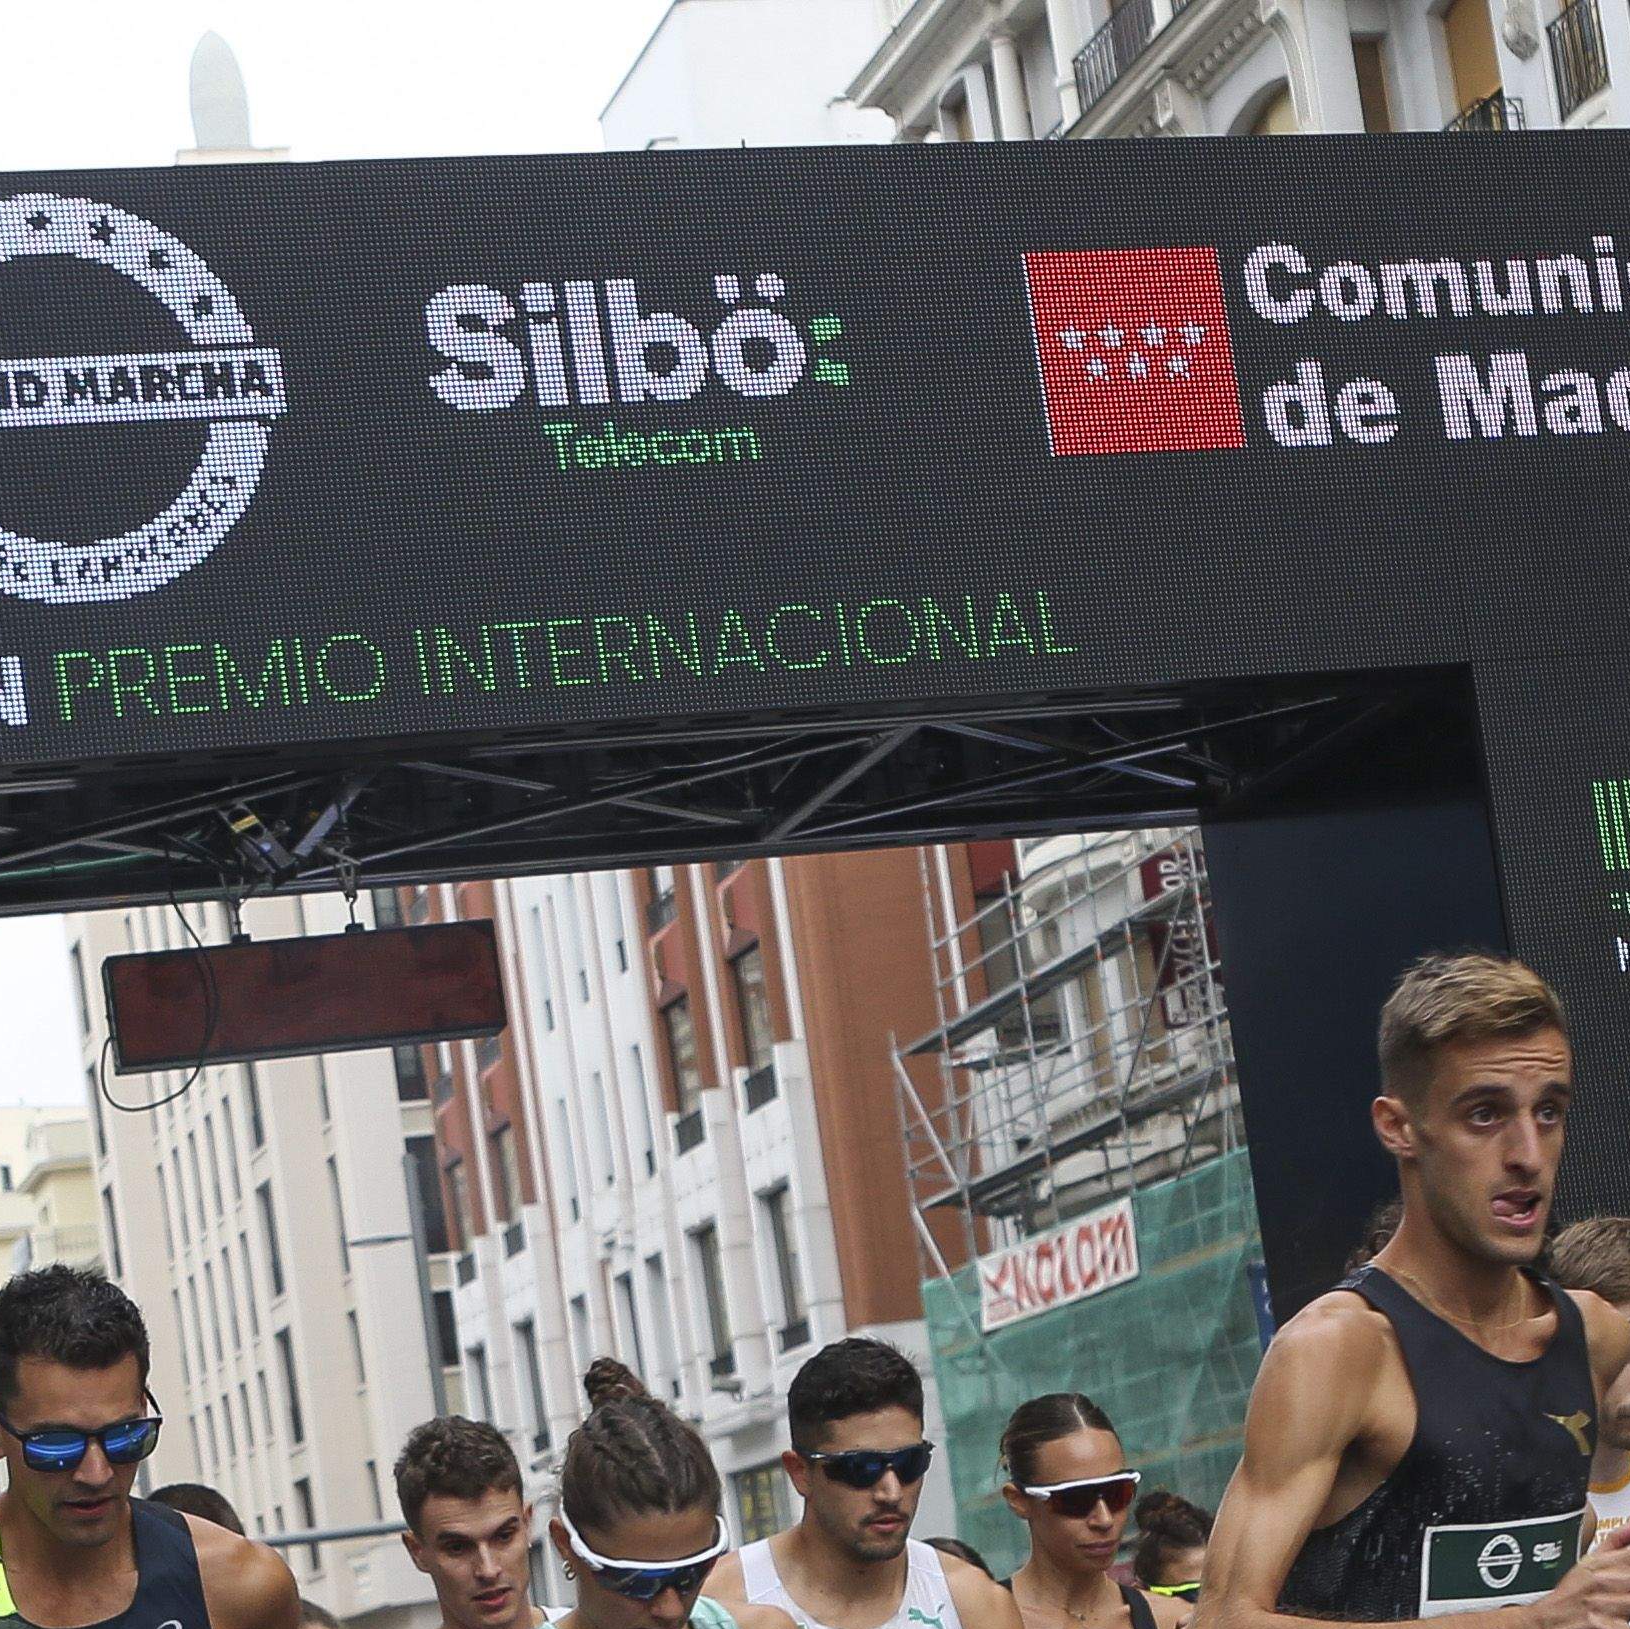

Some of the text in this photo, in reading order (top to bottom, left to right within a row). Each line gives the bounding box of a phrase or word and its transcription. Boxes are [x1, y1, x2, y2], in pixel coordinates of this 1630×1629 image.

[58, 358, 274, 408] MARCHA
[1261, 360, 1401, 449] de
[543, 422, 762, 471] Telecom
[54, 632, 385, 721] PREMIO
[413, 590, 1080, 697] INTERNACIONAL
